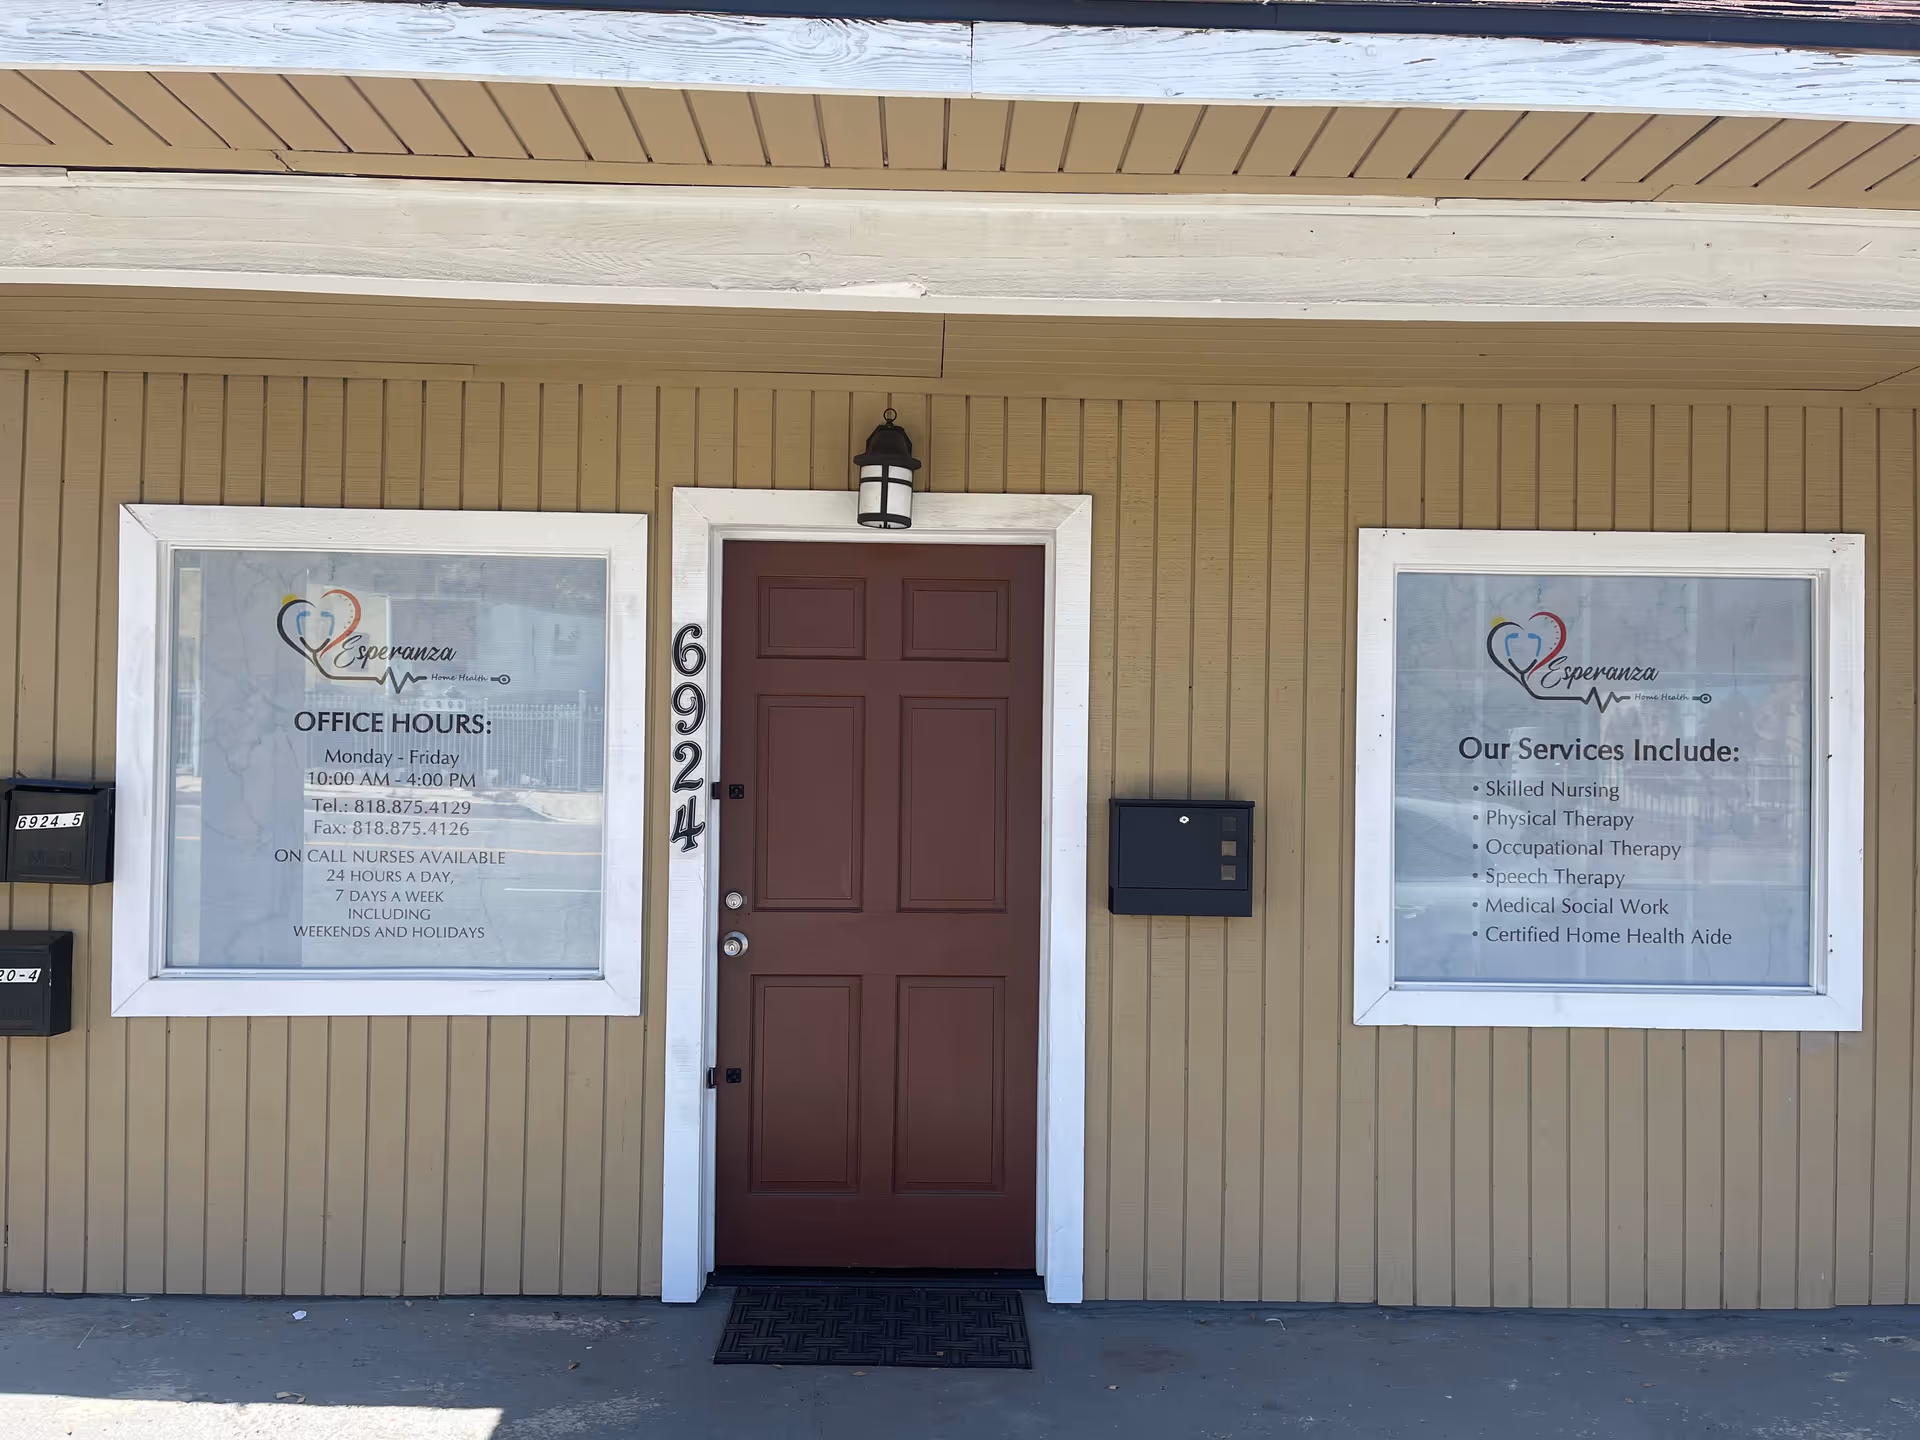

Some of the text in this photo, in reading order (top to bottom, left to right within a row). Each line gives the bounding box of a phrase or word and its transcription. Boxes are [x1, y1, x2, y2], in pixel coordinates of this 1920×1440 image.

[334, 635, 456, 668] Esperanza
[431, 673, 488, 682] Home Health
[1540, 656, 1660, 689] Esperanza
[1634, 693, 1690, 701] Home Health
[294, 711, 492, 735] OFFICE HOURS:
[671, 623, 706, 852] 6924
[325, 748, 393, 765] Monday
[410, 750, 460, 768] Friday
[1459, 736, 1740, 762] Our Services Include:
[308, 771, 354, 786] 10:00
[360, 772, 390, 787] AM
[406, 773, 443, 787] 4:00
[449, 773, 476, 788] PM
[1486, 780, 1619, 801] Skilled Nursing
[312, 798, 471, 815] Tel.: 818.875.4129
[18, 813, 81, 829] 6924.5
[314, 820, 470, 836] Fax: 818.875.4126
[1486, 809, 1634, 830] Physical Therapy
[274, 849, 506, 865] ON CALL NURSES AVAILABLE
[1486, 838, 1682, 860] Occupational Therapy
[326, 869, 454, 885] 24 HOURS A DAY,
[1485, 867, 1625, 888] Speech Therapy
[335, 889, 444, 903] 7 DAYS A WEEK
[348, 908, 431, 921] INCLUDING
[1485, 897, 1669, 915] Medical Social Work
[293, 925, 485, 939] WEEKENDS AND HOLIDAYS
[1485, 925, 1732, 945] Certified Home Health Aide
